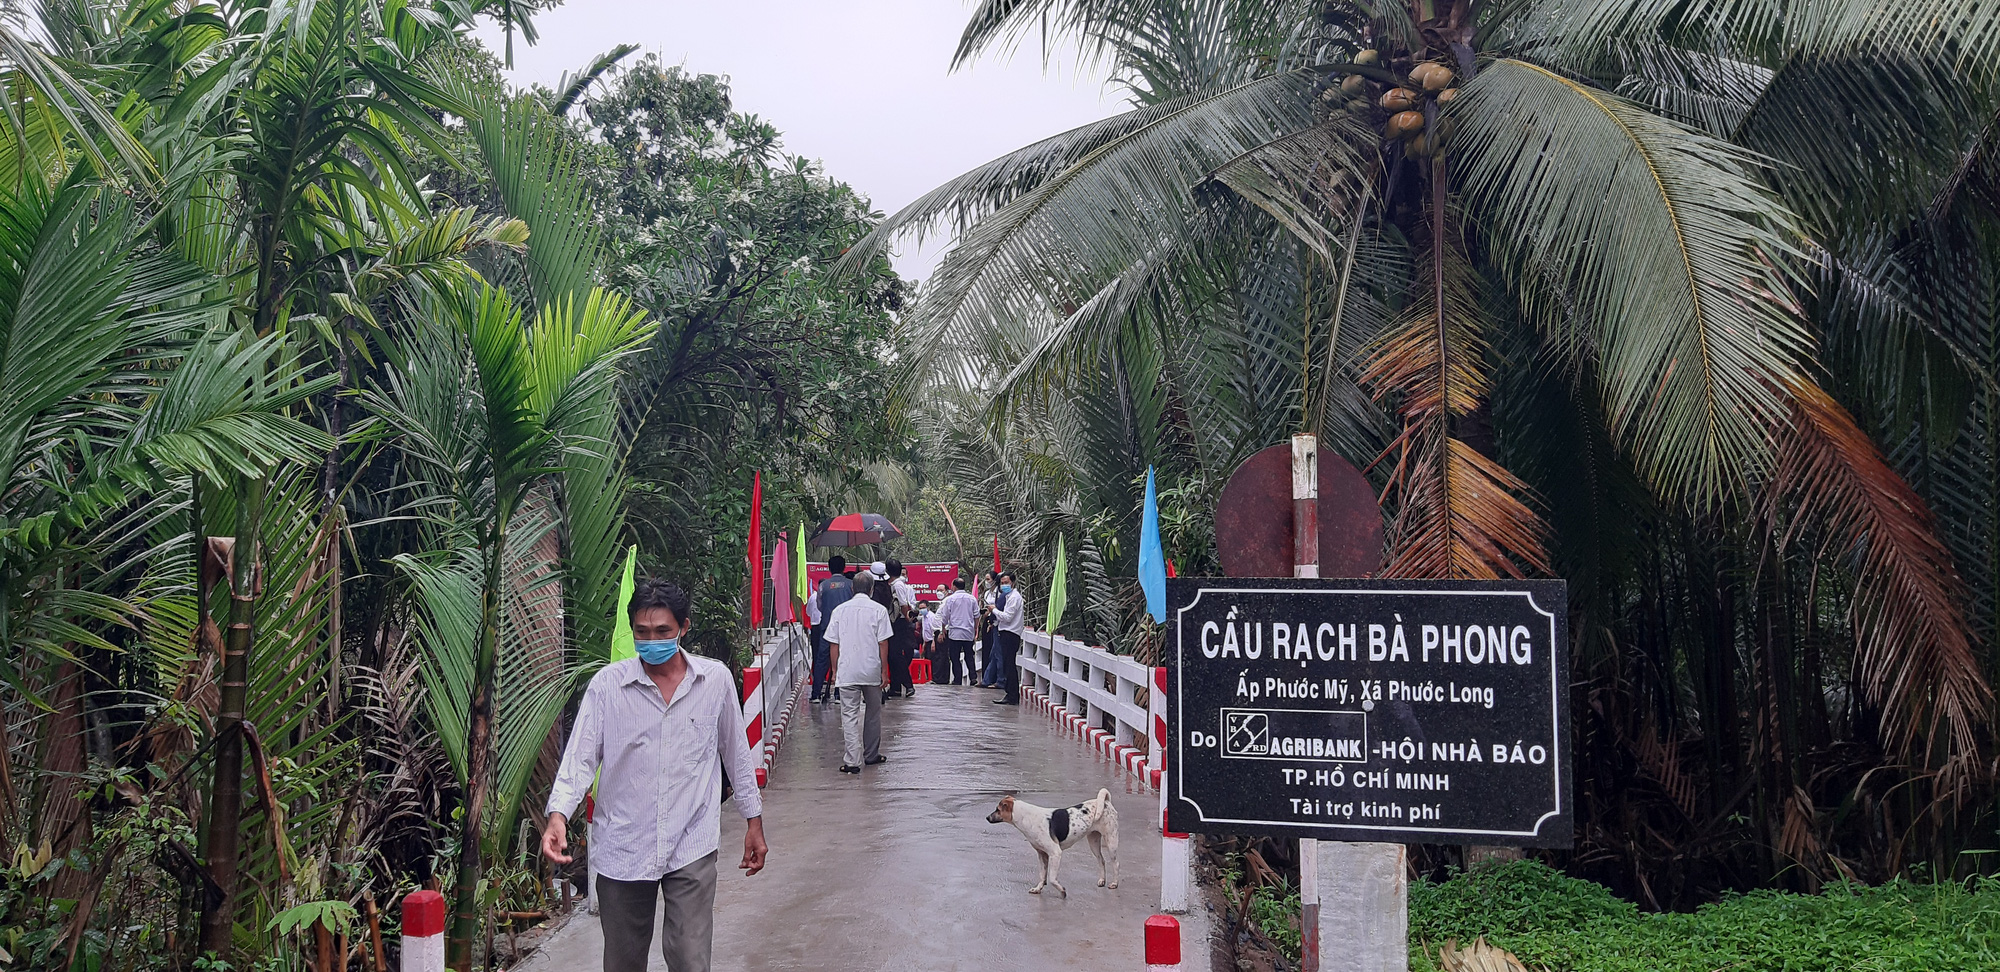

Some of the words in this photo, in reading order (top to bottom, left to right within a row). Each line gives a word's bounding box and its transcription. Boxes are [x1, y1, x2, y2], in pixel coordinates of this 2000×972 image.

[1200, 606, 1262, 660] CẦU
[1273, 622, 1357, 668] RẠCH
[1368, 614, 1410, 662] BÀ
[1422, 625, 1532, 666] PHONG
[1236, 669, 1260, 703] Ấp
[1265, 678, 1319, 700] Phước
[1324, 679, 1355, 705] Mỹ,
[1360, 680, 1382, 702] Xã
[1389, 680, 1445, 704] Phước
[1450, 682, 1494, 709] Long
[1230, 716, 1238, 724] V
[1191, 731, 1217, 748] Do
[1269, 737, 1362, 759] AGRIBANK
[1432, 739, 1483, 764] NHÀ
[1493, 740, 1546, 765] BÁO
[1281, 764, 1345, 788] TP.HỒ
[1352, 768, 1389, 789] CHÍ
[1395, 773, 1449, 791] MINH
[1290, 799, 1320, 816] Tài
[1326, 801, 1353, 819] trợ
[1361, 802, 1402, 819] kinh
[1409, 803, 1441, 823] phí
